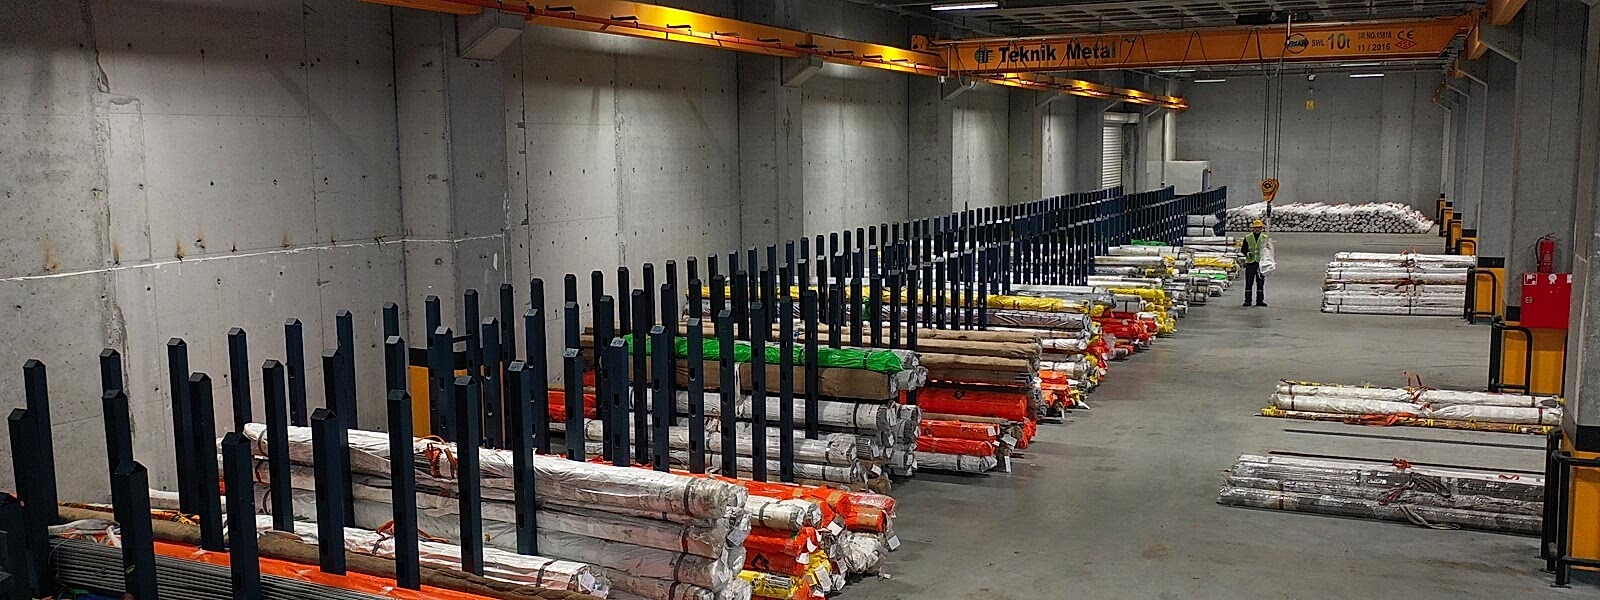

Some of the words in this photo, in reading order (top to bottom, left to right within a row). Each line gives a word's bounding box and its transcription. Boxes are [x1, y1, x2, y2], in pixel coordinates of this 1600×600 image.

[1327, 32, 1351, 50] 10t
[1372, 43, 1391, 51] 2016
[998, 43, 1057, 63] Teknik
[1066, 41, 1116, 60] Metal
